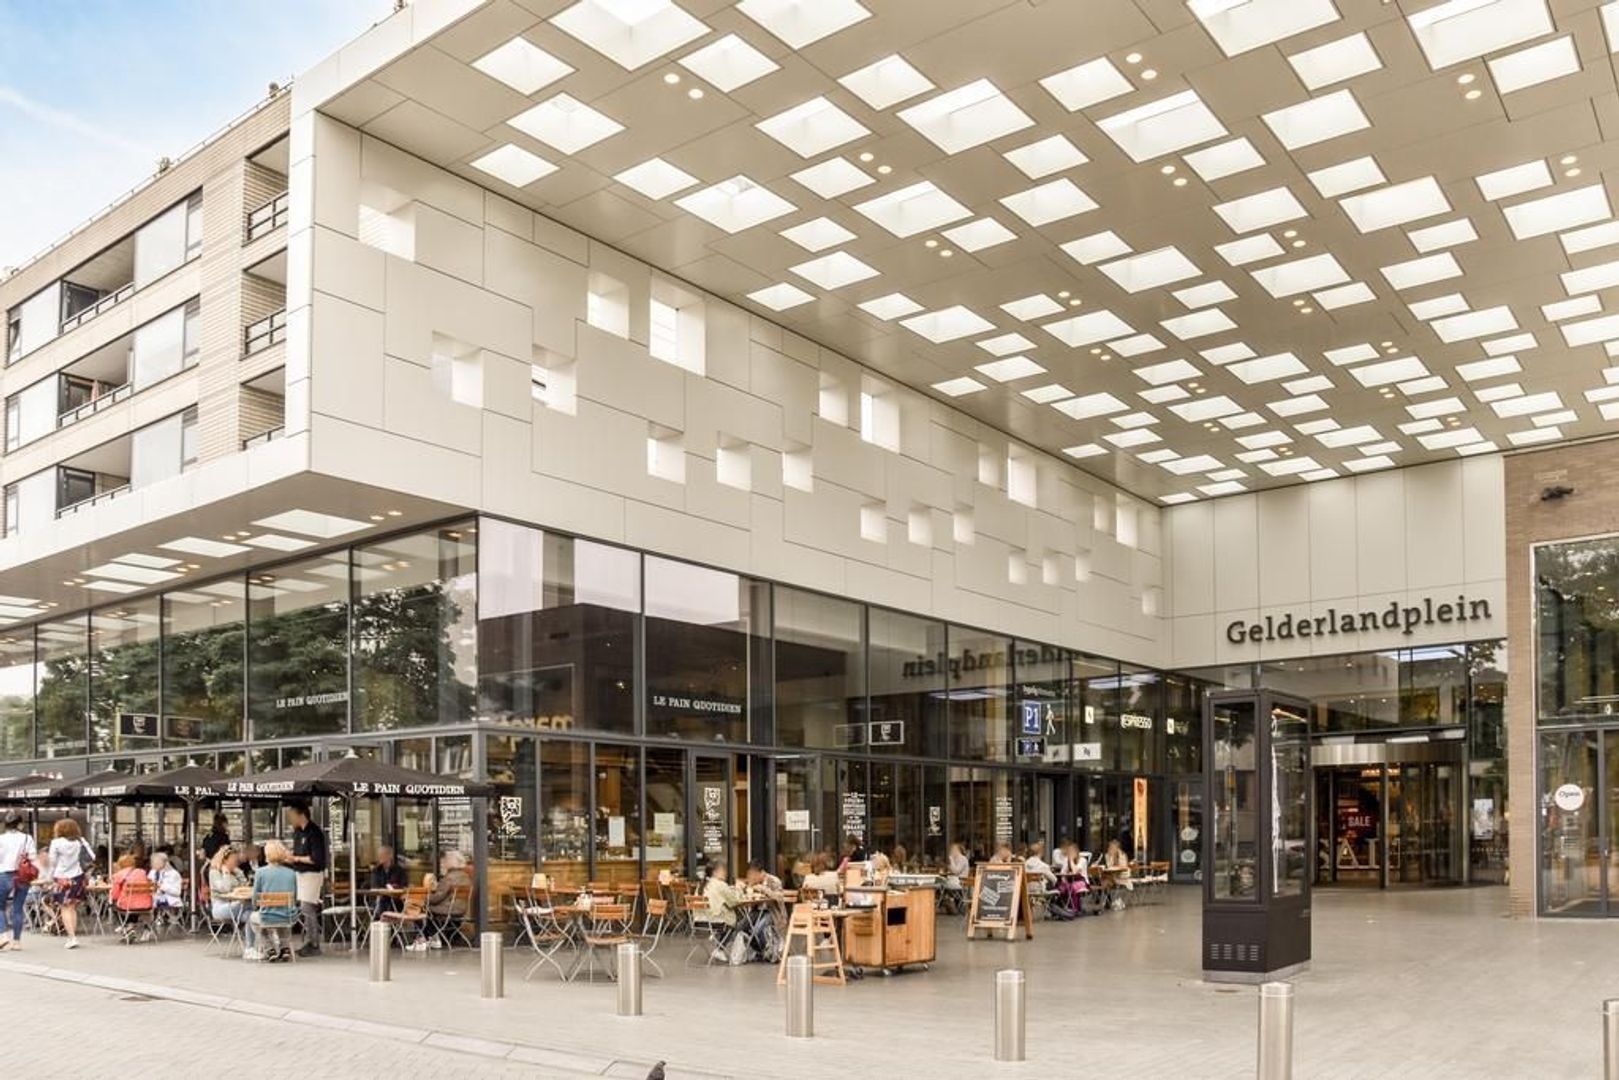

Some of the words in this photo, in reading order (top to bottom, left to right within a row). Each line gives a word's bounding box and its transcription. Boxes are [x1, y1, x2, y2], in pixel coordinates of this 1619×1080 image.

[1227, 596, 1492, 643] Gelderlandplein
[653, 696, 666, 706] LE
[669, 697, 691, 708] PAIN
[693, 700, 741, 713] QUOTIDIEN
[1025, 706, 1039, 728] P1
[174, 786, 189, 795] LE
[195, 786, 219, 796] PAI
[353, 782, 369, 792] LE
[374, 783, 400, 794] PAIN
[405, 784, 465, 795] QUOTIDIEN
[1348, 816, 1371, 827] SALE
